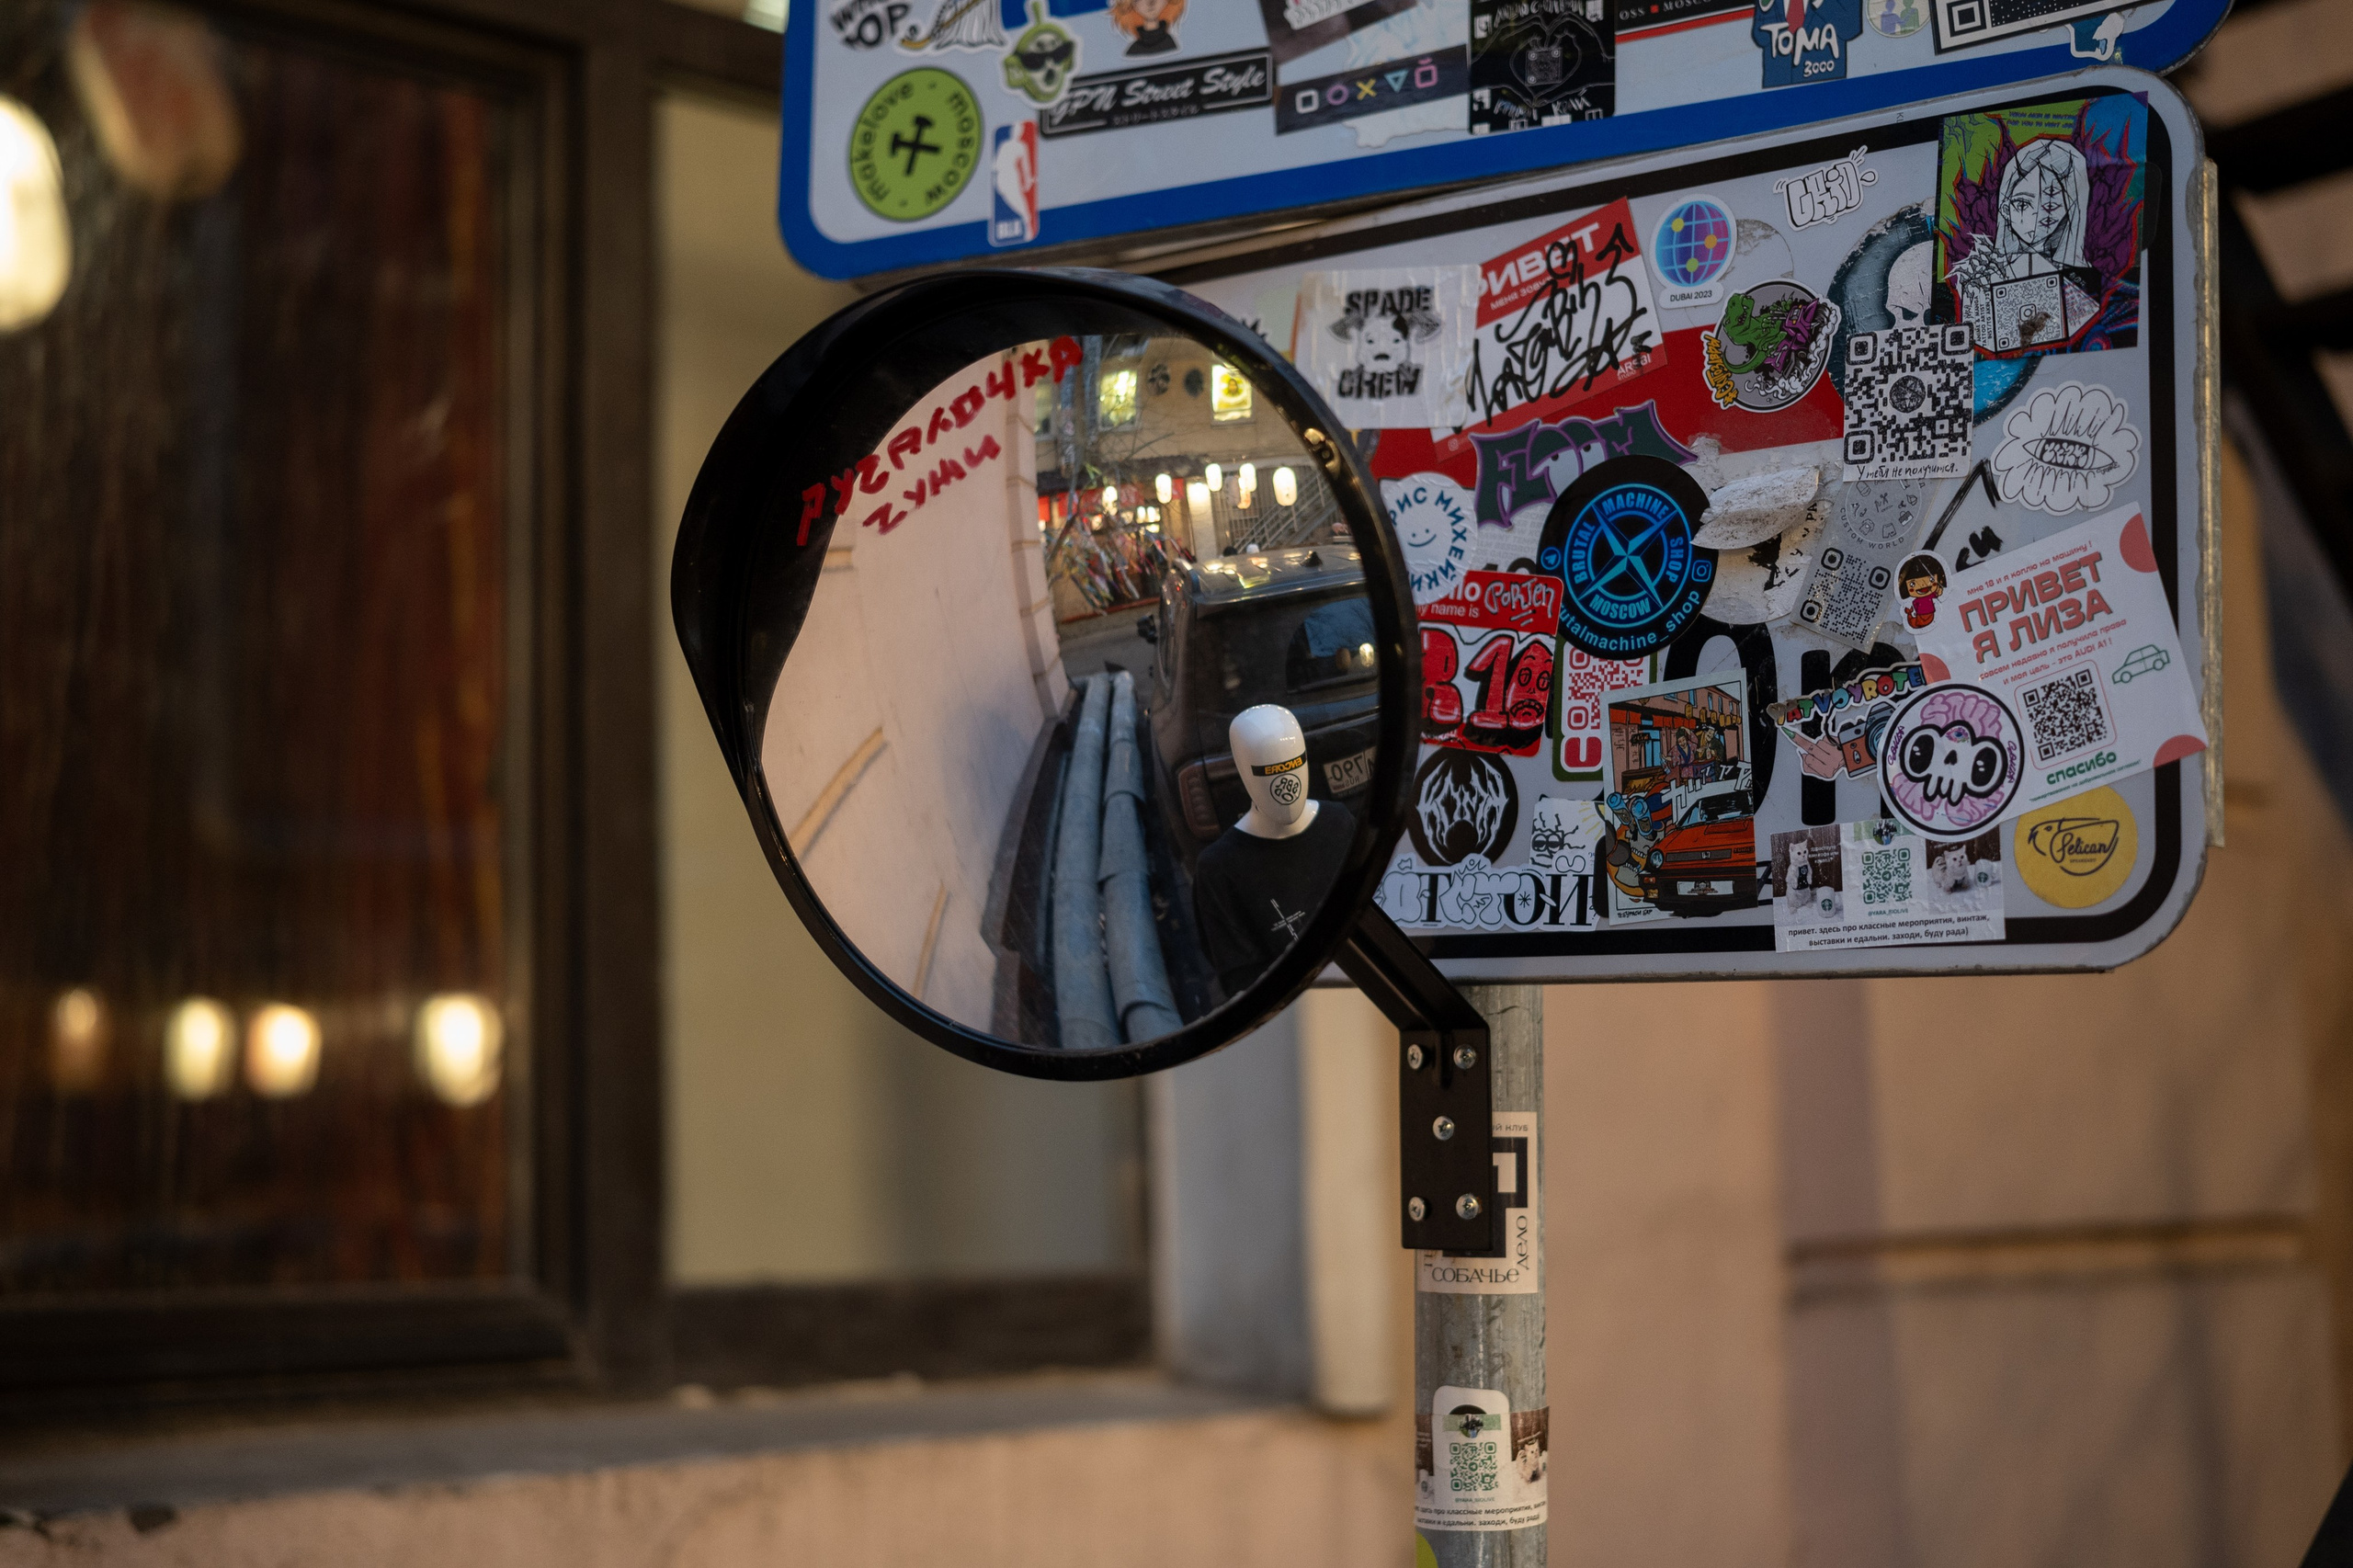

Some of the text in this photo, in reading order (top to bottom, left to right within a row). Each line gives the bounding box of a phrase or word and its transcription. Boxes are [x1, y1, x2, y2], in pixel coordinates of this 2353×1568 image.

[1760, 22, 1839, 66] TOMA
[1199, 64, 1267, 97] Style
[1803, 60, 1836, 78] 3000
[924, 91, 975, 205] moscow
[1345, 286, 1431, 317] SPADE
[1669, 290, 1712, 301] DUBAI 2023
[1337, 367, 1421, 399] CREW
[1857, 465, 1865, 481] У
[1866, 465, 1889, 479] тебя
[1892, 466, 1903, 477] не
[1602, 492, 1669, 519] MACHINE
[1840, 507, 1904, 550] CUSTOM WORLD
[1572, 520, 1596, 585] BRUTAL
[1666, 537, 1684, 583] SHOP
[1958, 551, 2102, 633] ПРИВЕТ
[1967, 584, 1983, 597] мне
[1984, 577, 1995, 588] 18
[2011, 562, 2039, 579] коплю
[1430, 604, 1465, 617] name
[1469, 606, 1480, 618] is
[1589, 595, 1651, 619] MOSCOW
[1972, 588, 2112, 664] Я ЛИЗА
[1979, 662, 2009, 680] совсем
[2010, 650, 2048, 669] недавно
[2056, 631, 2099, 653] получила
[2100, 619, 2127, 637] права
[2010, 670, 2026, 681] моя
[2028, 663, 2050, 675] цель
[2058, 654, 2073, 666] это
[2075, 644, 2097, 659] AUDI
[2046, 750, 2117, 785] спасибо
[2053, 832, 2112, 862] Pelican
[1788, 914, 1990, 938] привет. здесь про классные мероприятия, винтаж,
[1809, 937, 1843, 948] выставки
[1854, 932, 1890, 944] едальни.
[1892, 929, 1922, 942] заходи,
[1924, 926, 1944, 940] буду
[1945, 926, 1969, 939] рада)
